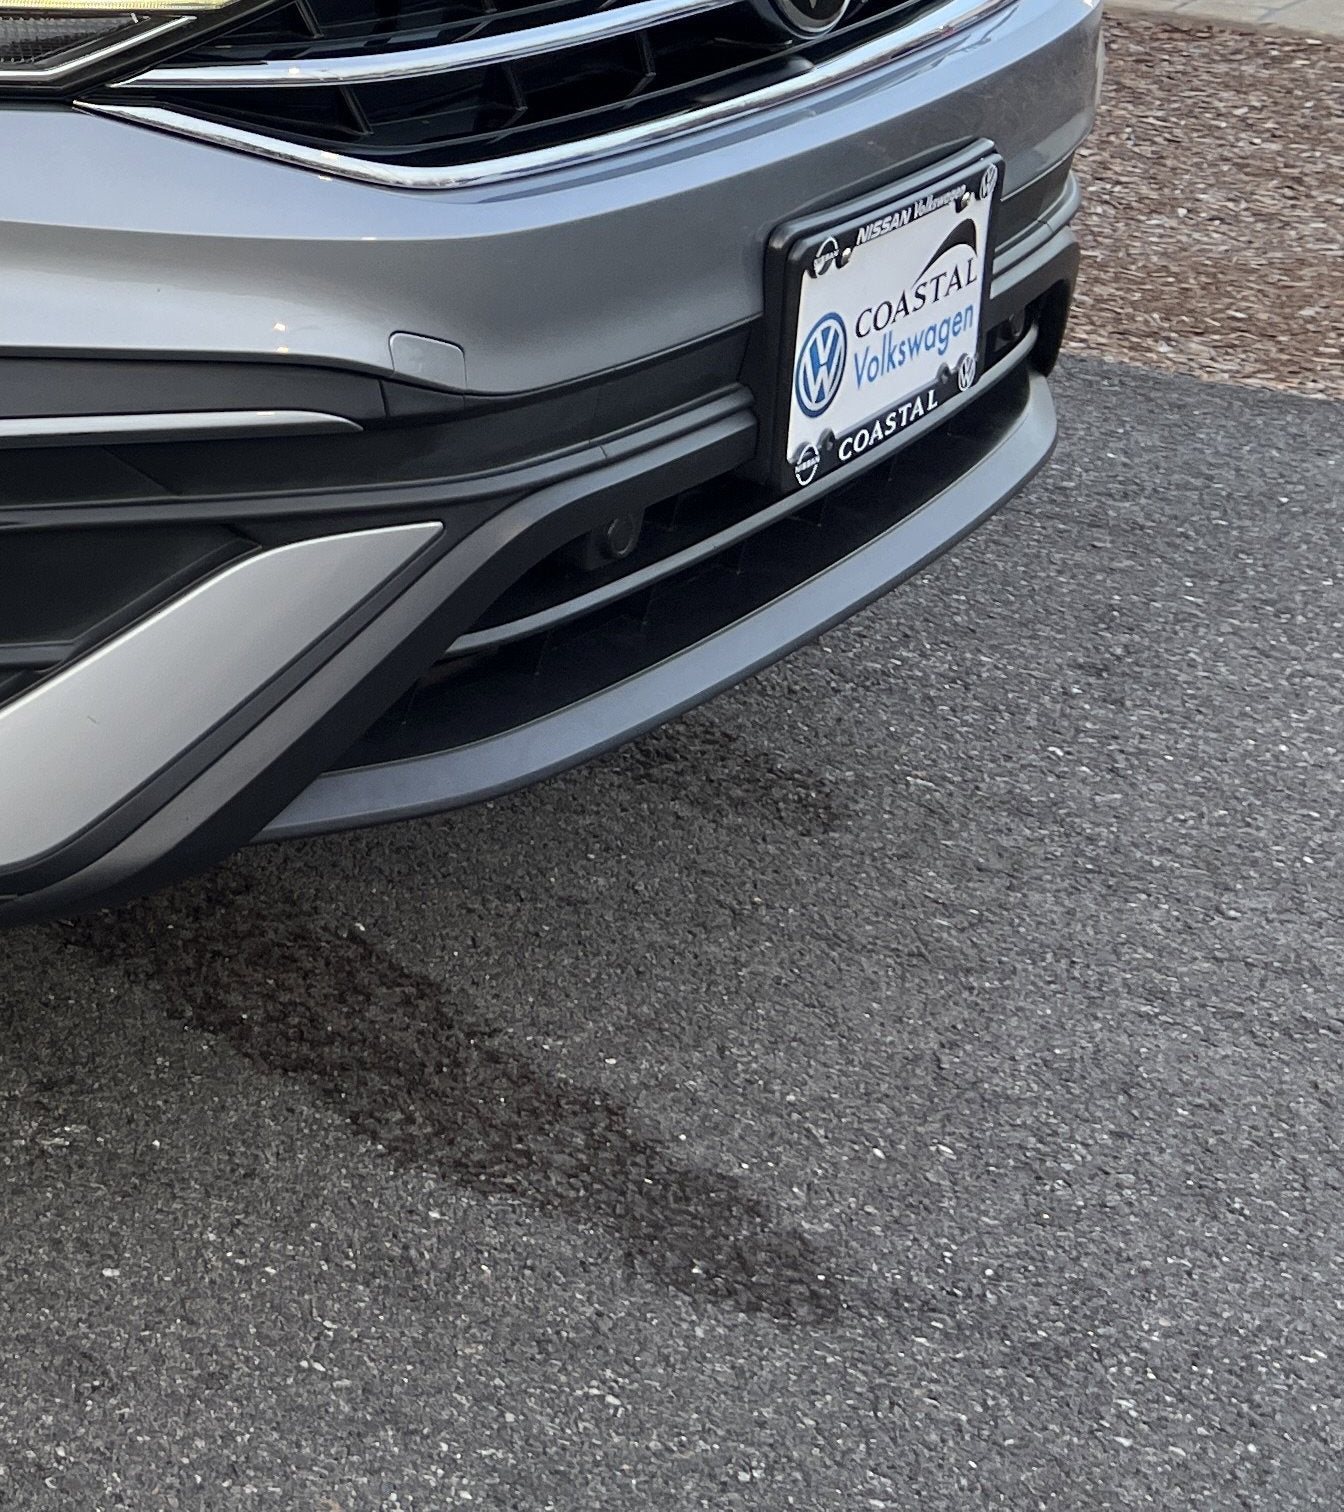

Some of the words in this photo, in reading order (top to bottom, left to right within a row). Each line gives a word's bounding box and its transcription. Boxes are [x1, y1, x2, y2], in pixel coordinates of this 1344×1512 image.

[856, 207, 911, 245] NISSAN
[855, 257, 977, 338] COASTAL
[797, 315, 846, 416] VW
[854, 304, 974, 390] Volkswagen
[838, 390, 939, 462] COASTAL
